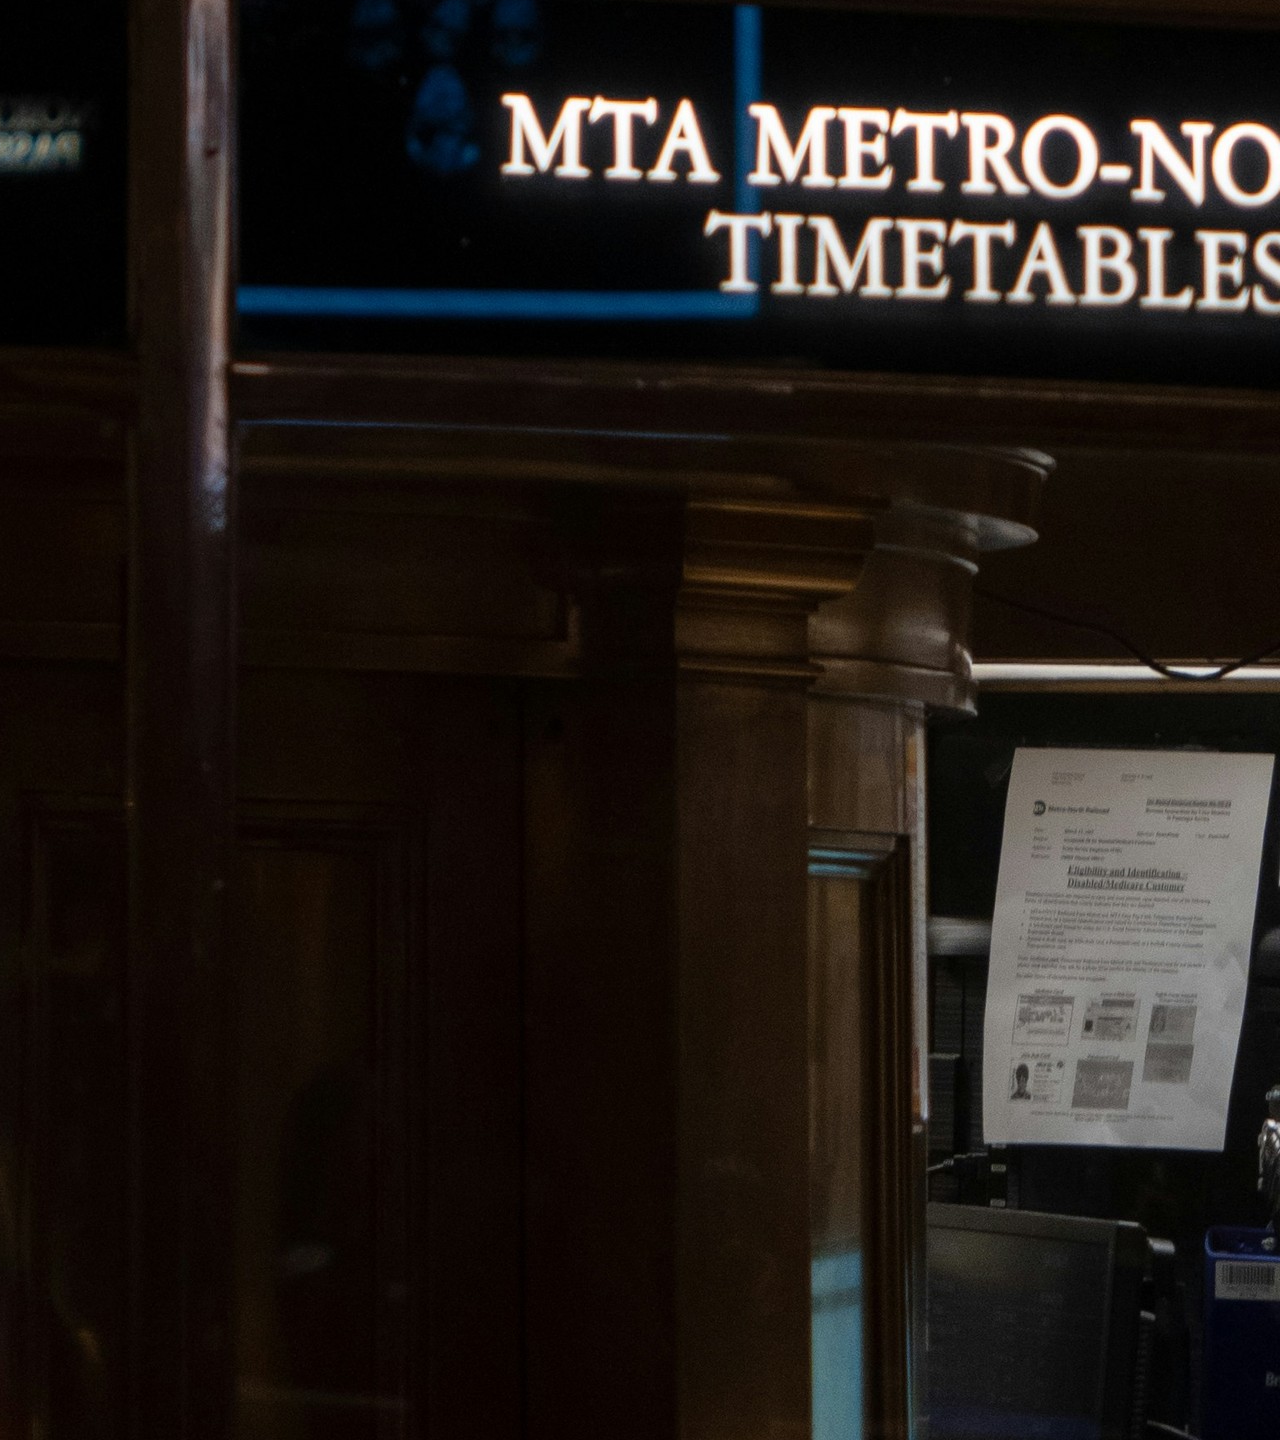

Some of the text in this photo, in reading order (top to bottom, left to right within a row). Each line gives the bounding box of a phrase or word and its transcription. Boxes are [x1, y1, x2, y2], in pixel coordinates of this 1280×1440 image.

[500, 92, 1280, 208] MTA METRO-NO
[1067, 865, 1181, 880] Eligibility and Identification
[1145, 882, 1186, 893] Customer
